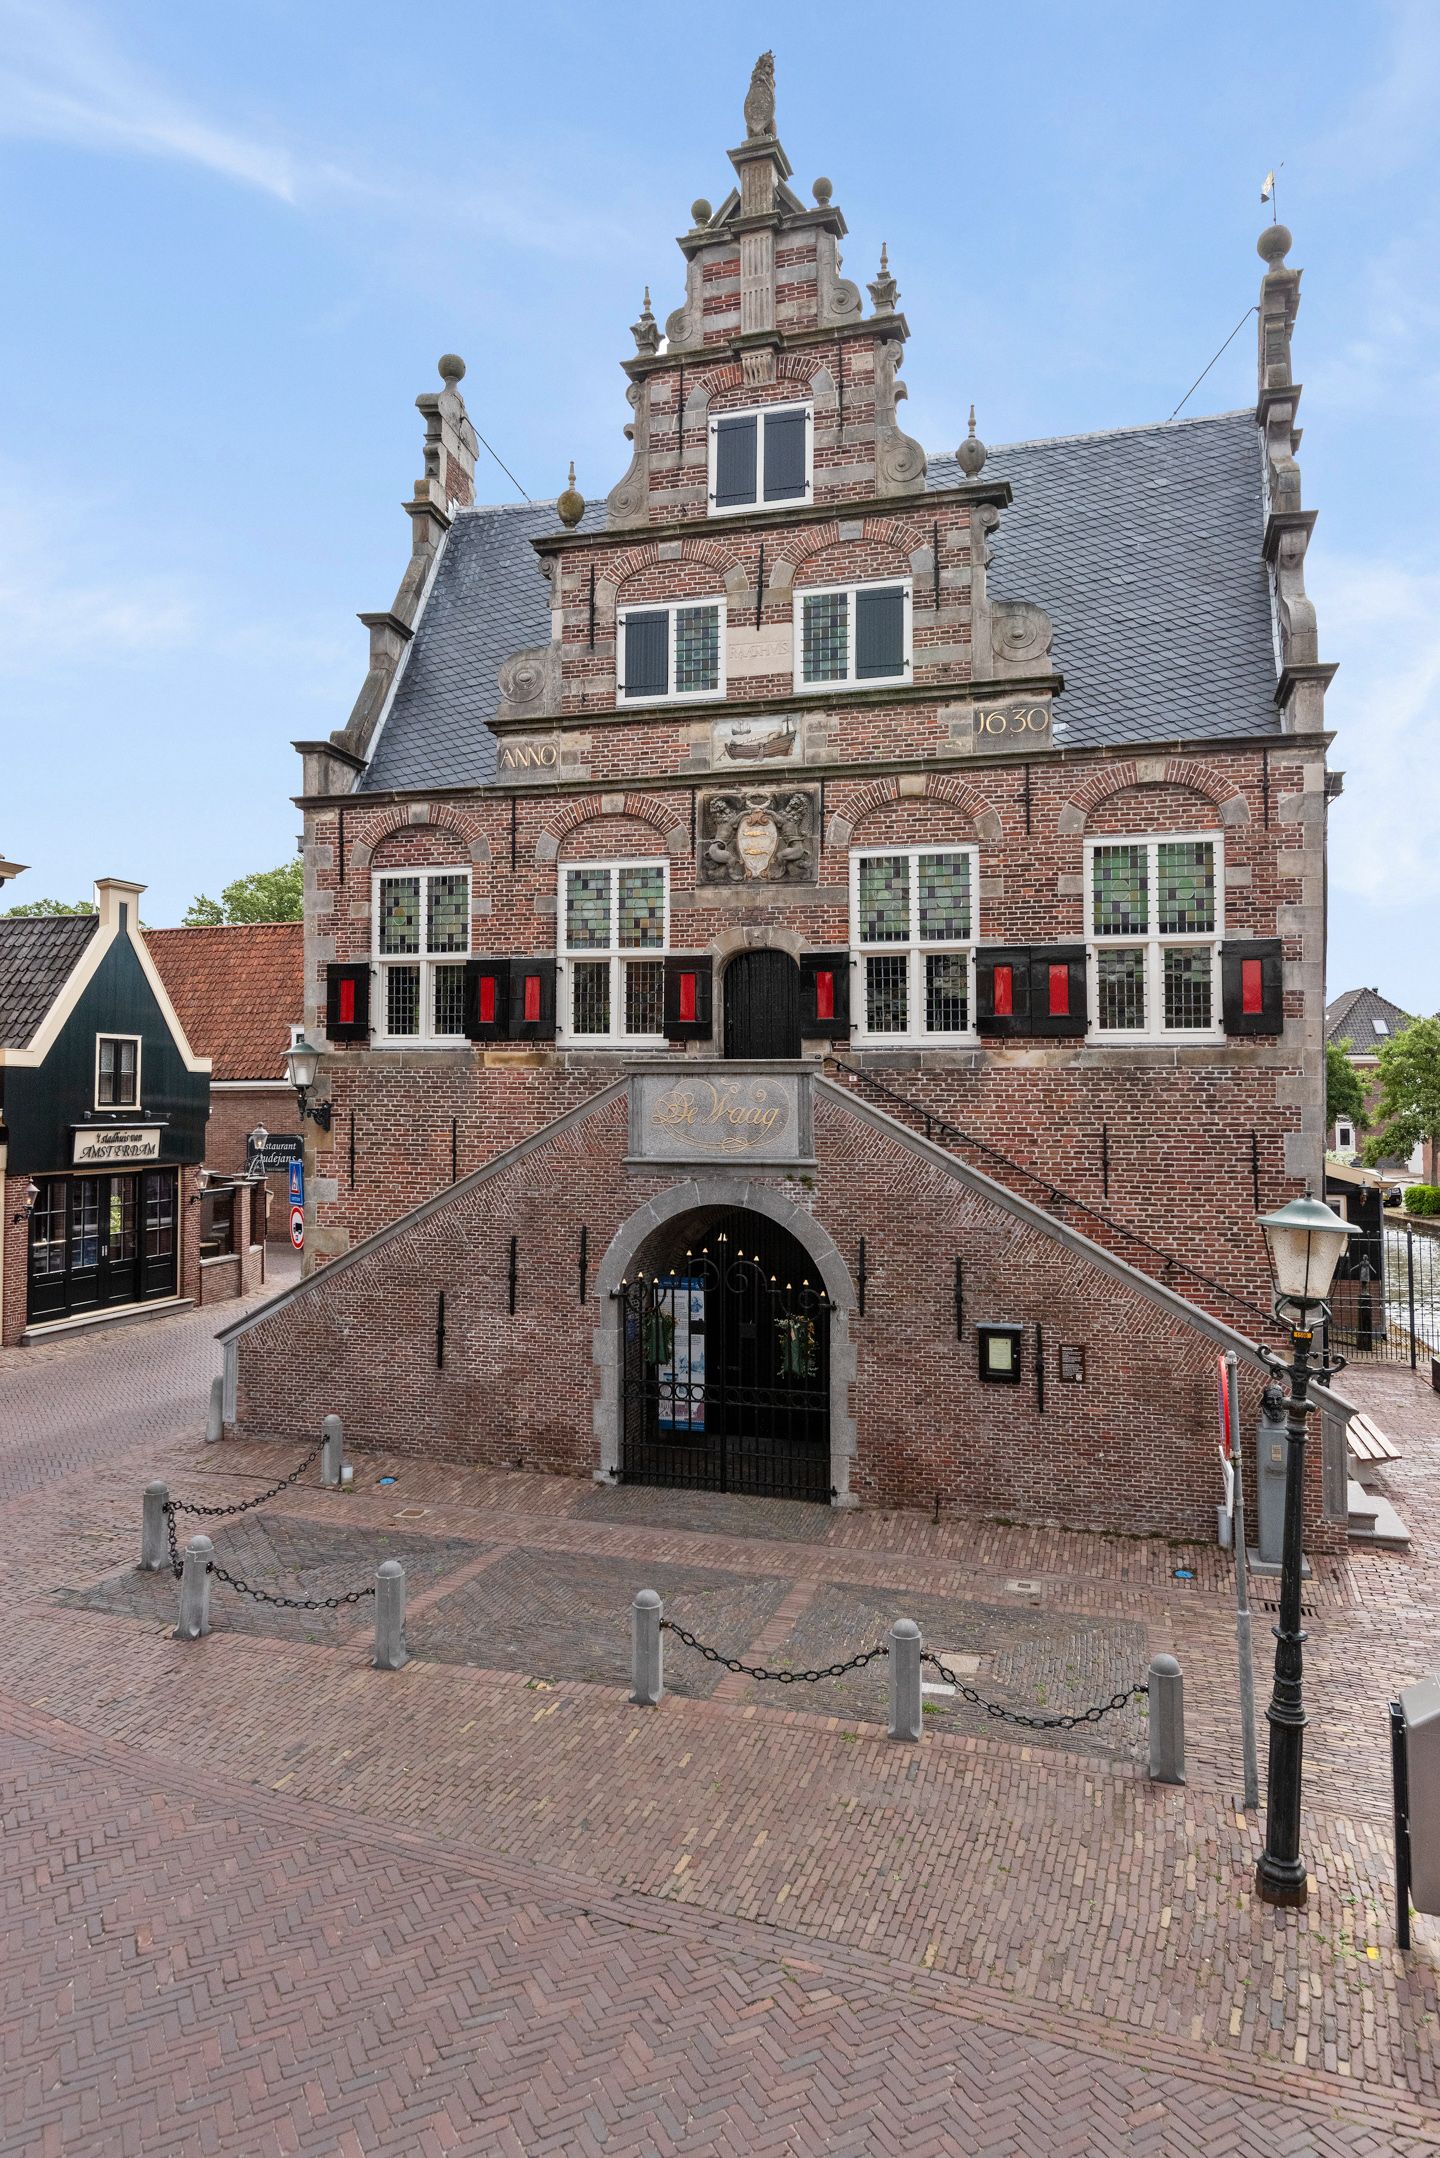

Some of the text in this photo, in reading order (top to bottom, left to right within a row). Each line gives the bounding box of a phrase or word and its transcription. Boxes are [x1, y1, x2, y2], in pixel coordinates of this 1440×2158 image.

[977, 707, 1049, 735] 1630
[499, 744, 557, 769] ANNO
[651, 1090, 699, 1125] De
[80, 1142, 156, 1159] AMSTERDAM
[264, 1142, 297, 1150] staurant
[263, 1151, 297, 1166] udejans
